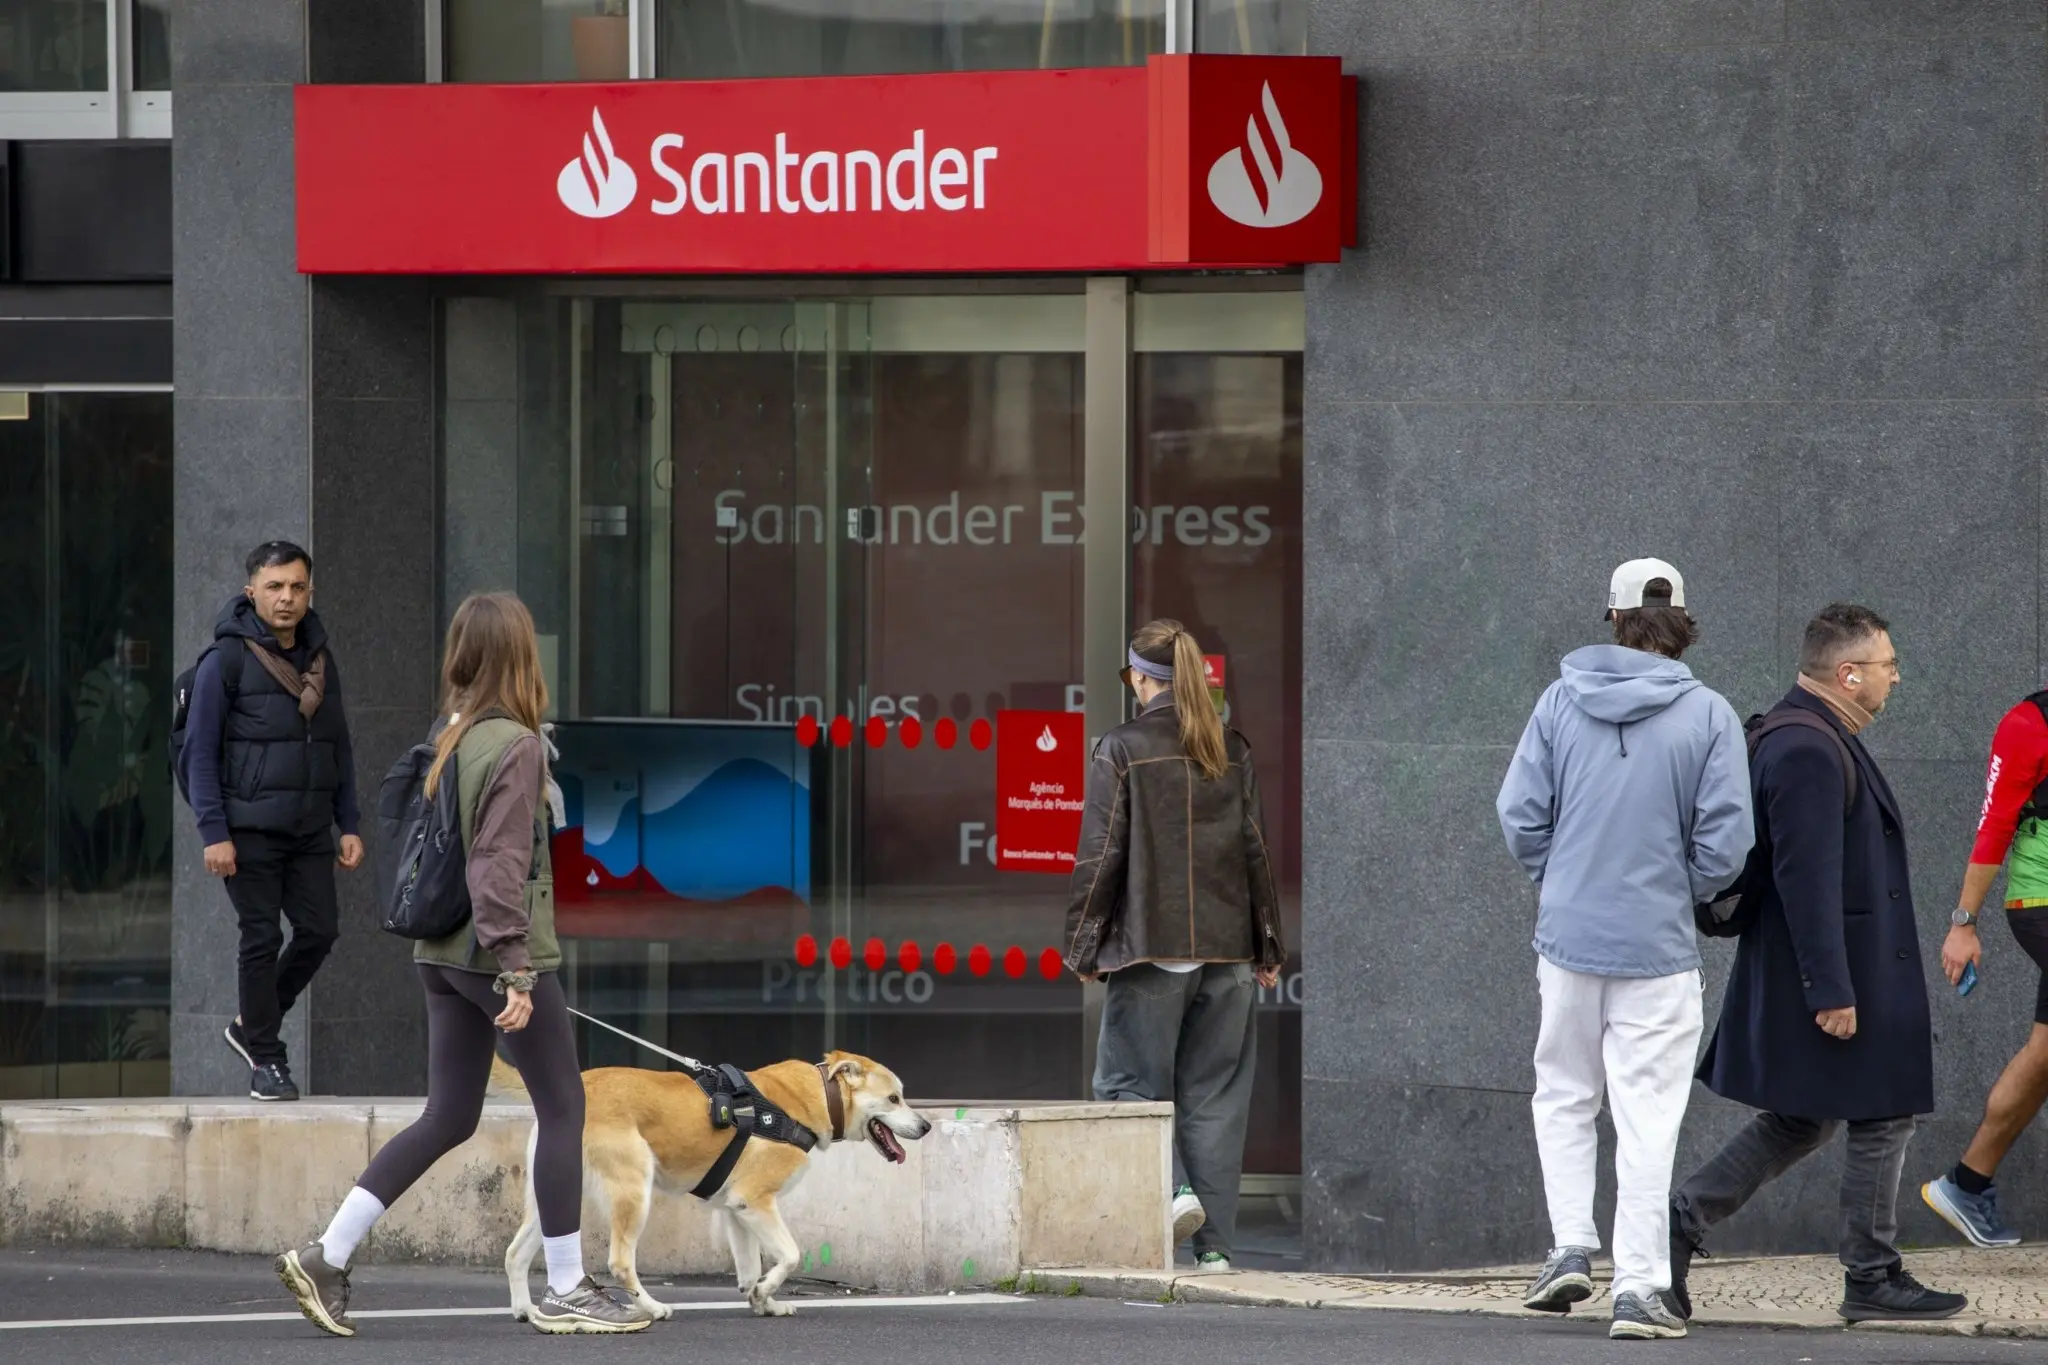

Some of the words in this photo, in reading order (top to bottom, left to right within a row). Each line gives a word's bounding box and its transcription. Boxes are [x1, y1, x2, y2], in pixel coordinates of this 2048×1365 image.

[650, 128, 998, 216] Santander
[714, 489, 1024, 546] Sanander
[1041, 490, 1272, 546] Eress
[1043, 798, 1054, 810] de
[544, 1297, 591, 1315] SALOMON
